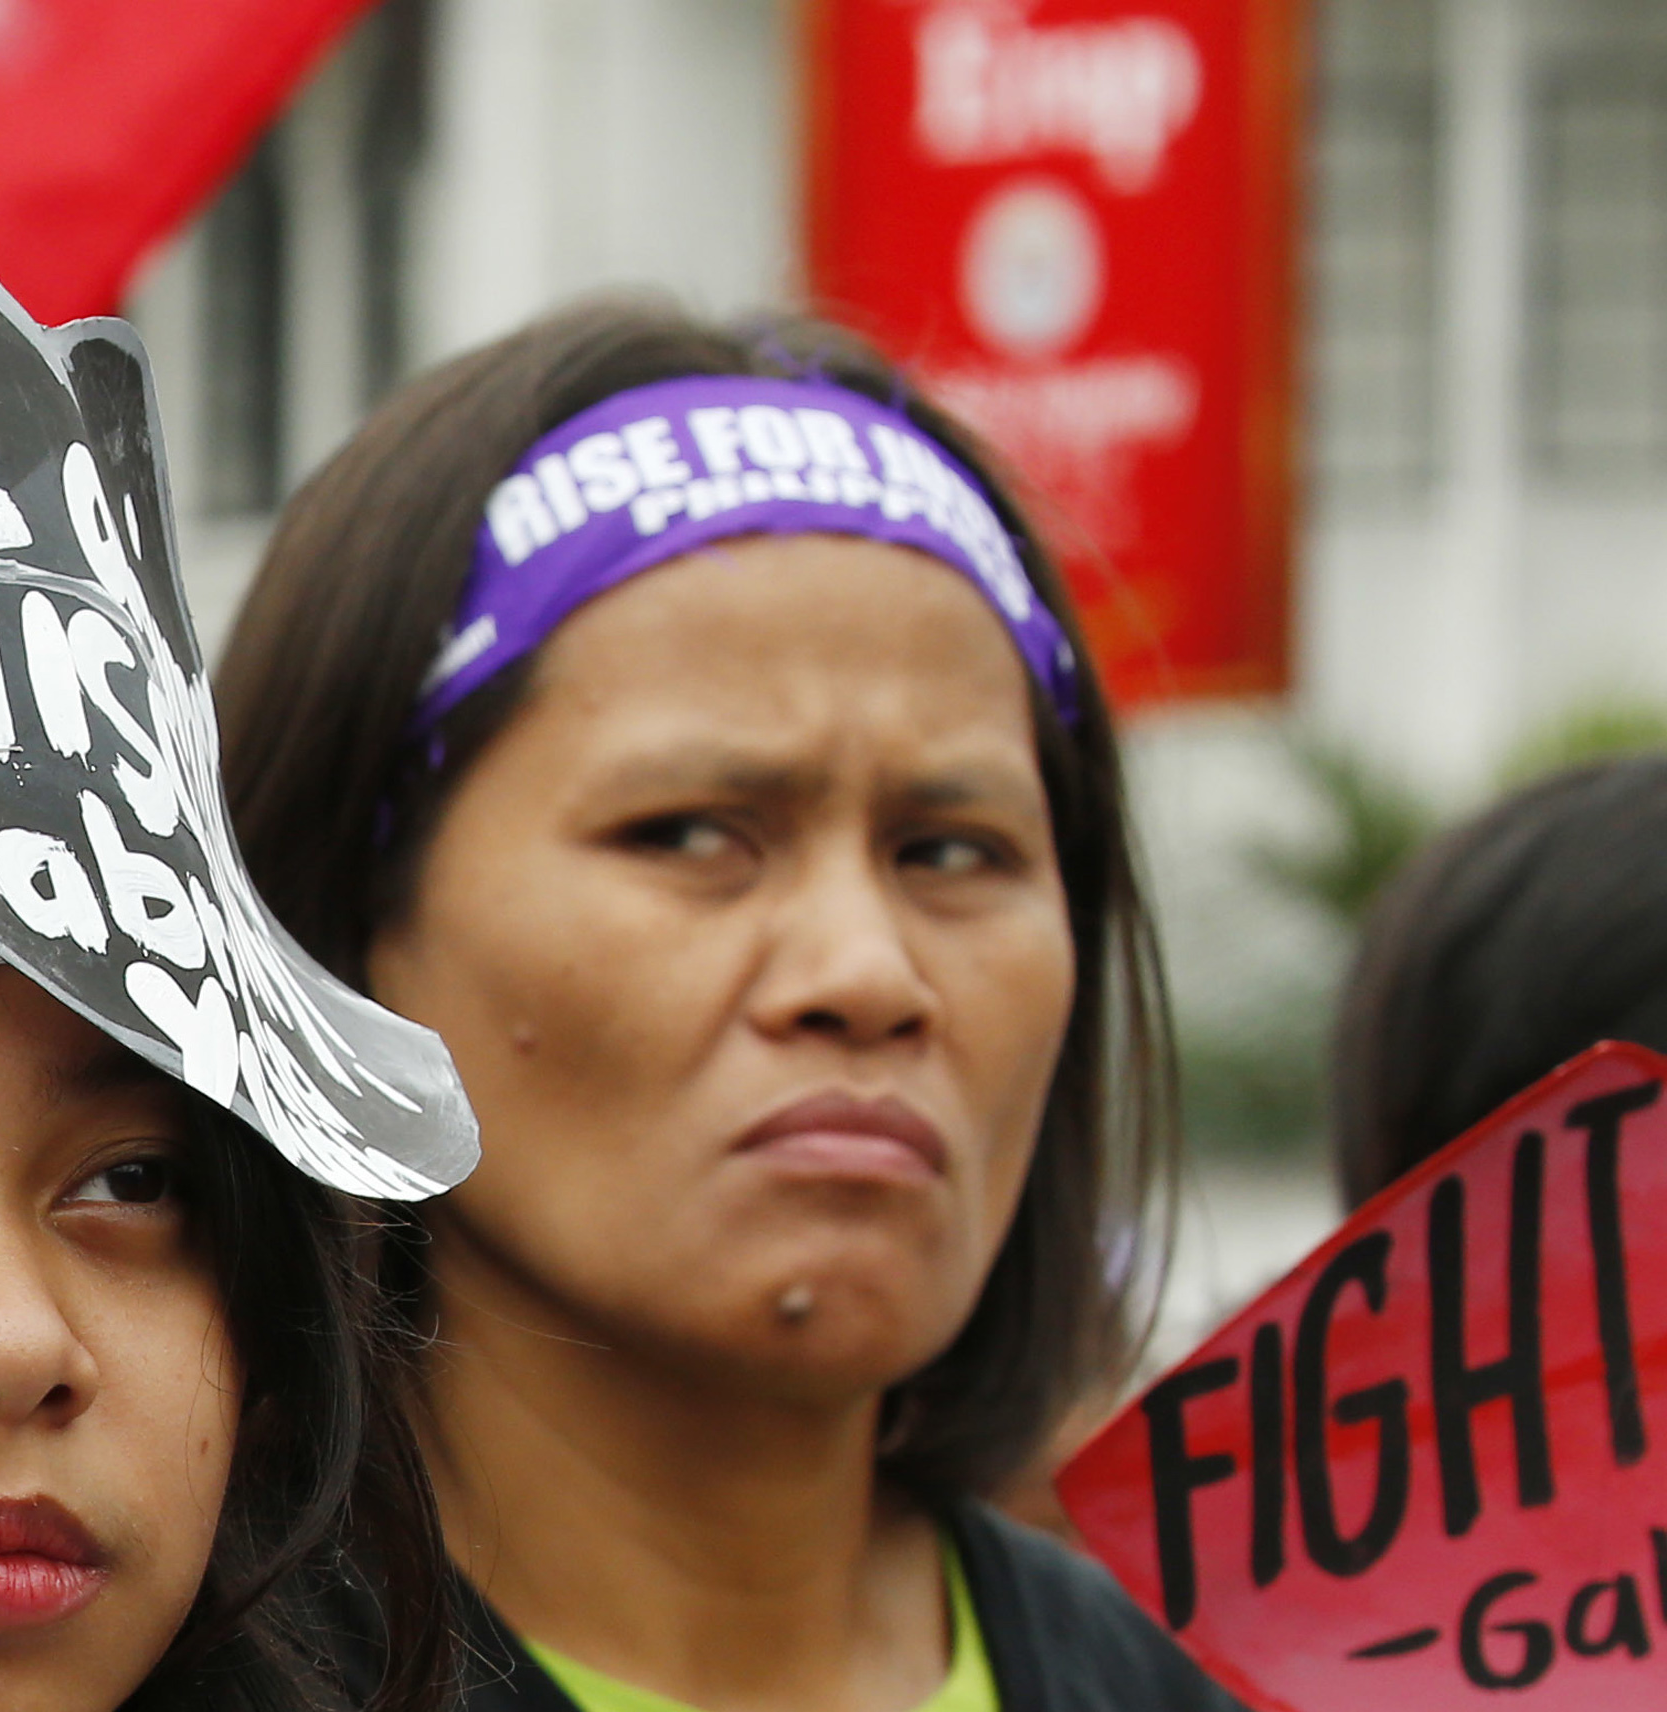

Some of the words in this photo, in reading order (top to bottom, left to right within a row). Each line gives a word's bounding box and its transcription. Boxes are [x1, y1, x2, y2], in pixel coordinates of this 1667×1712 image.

[485, 414, 691, 566] RISE
[685, 403, 871, 476] FOR
[1140, 1079, 1663, 1631] FIGHT
